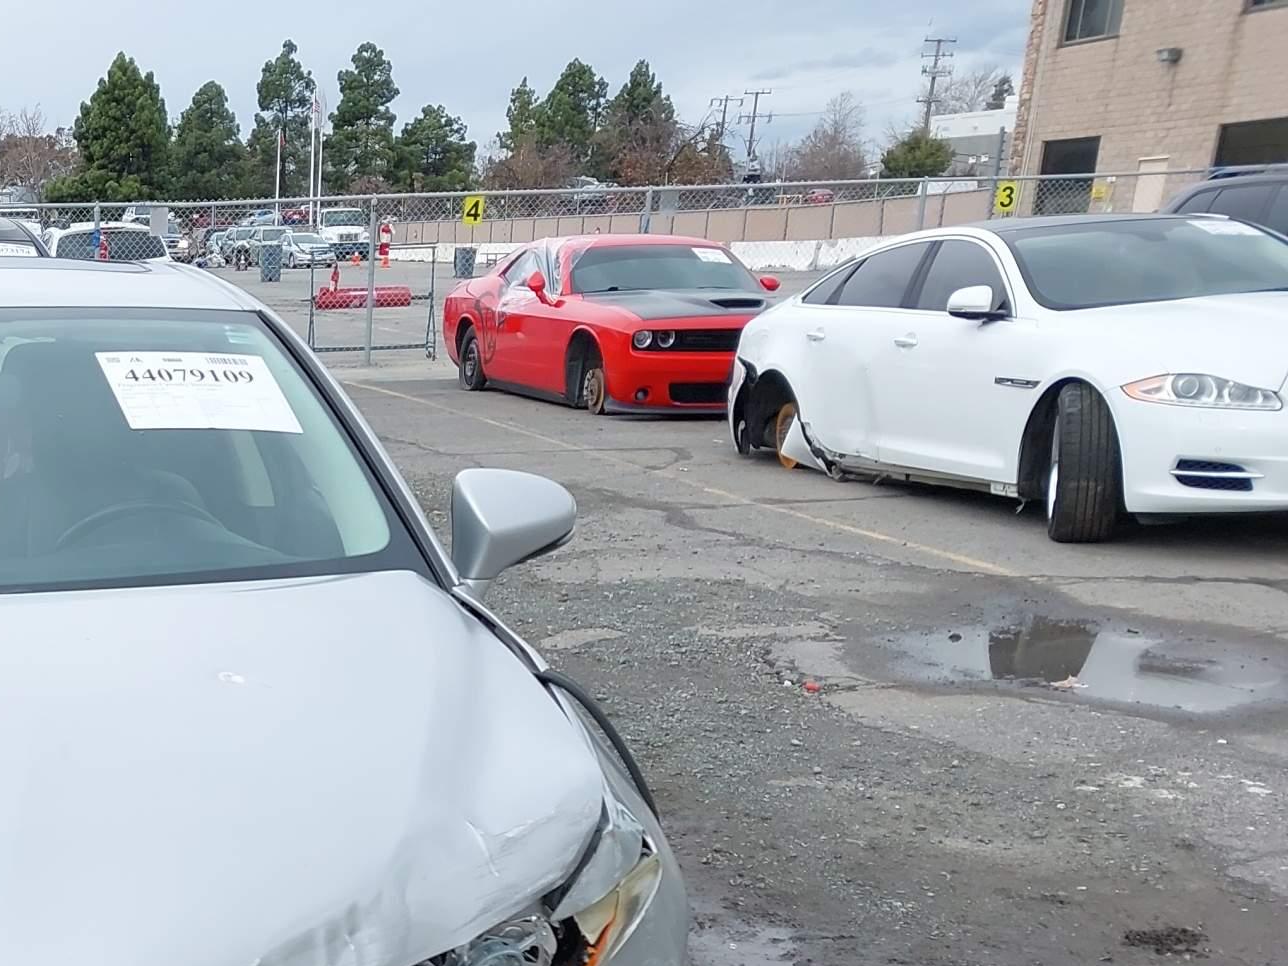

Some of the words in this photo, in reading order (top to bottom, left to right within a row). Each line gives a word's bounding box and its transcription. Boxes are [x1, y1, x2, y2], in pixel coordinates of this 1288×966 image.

[999, 186, 1014, 207] 3
[466, 199, 481, 221] 4
[124, 368, 254, 384] 44079109
